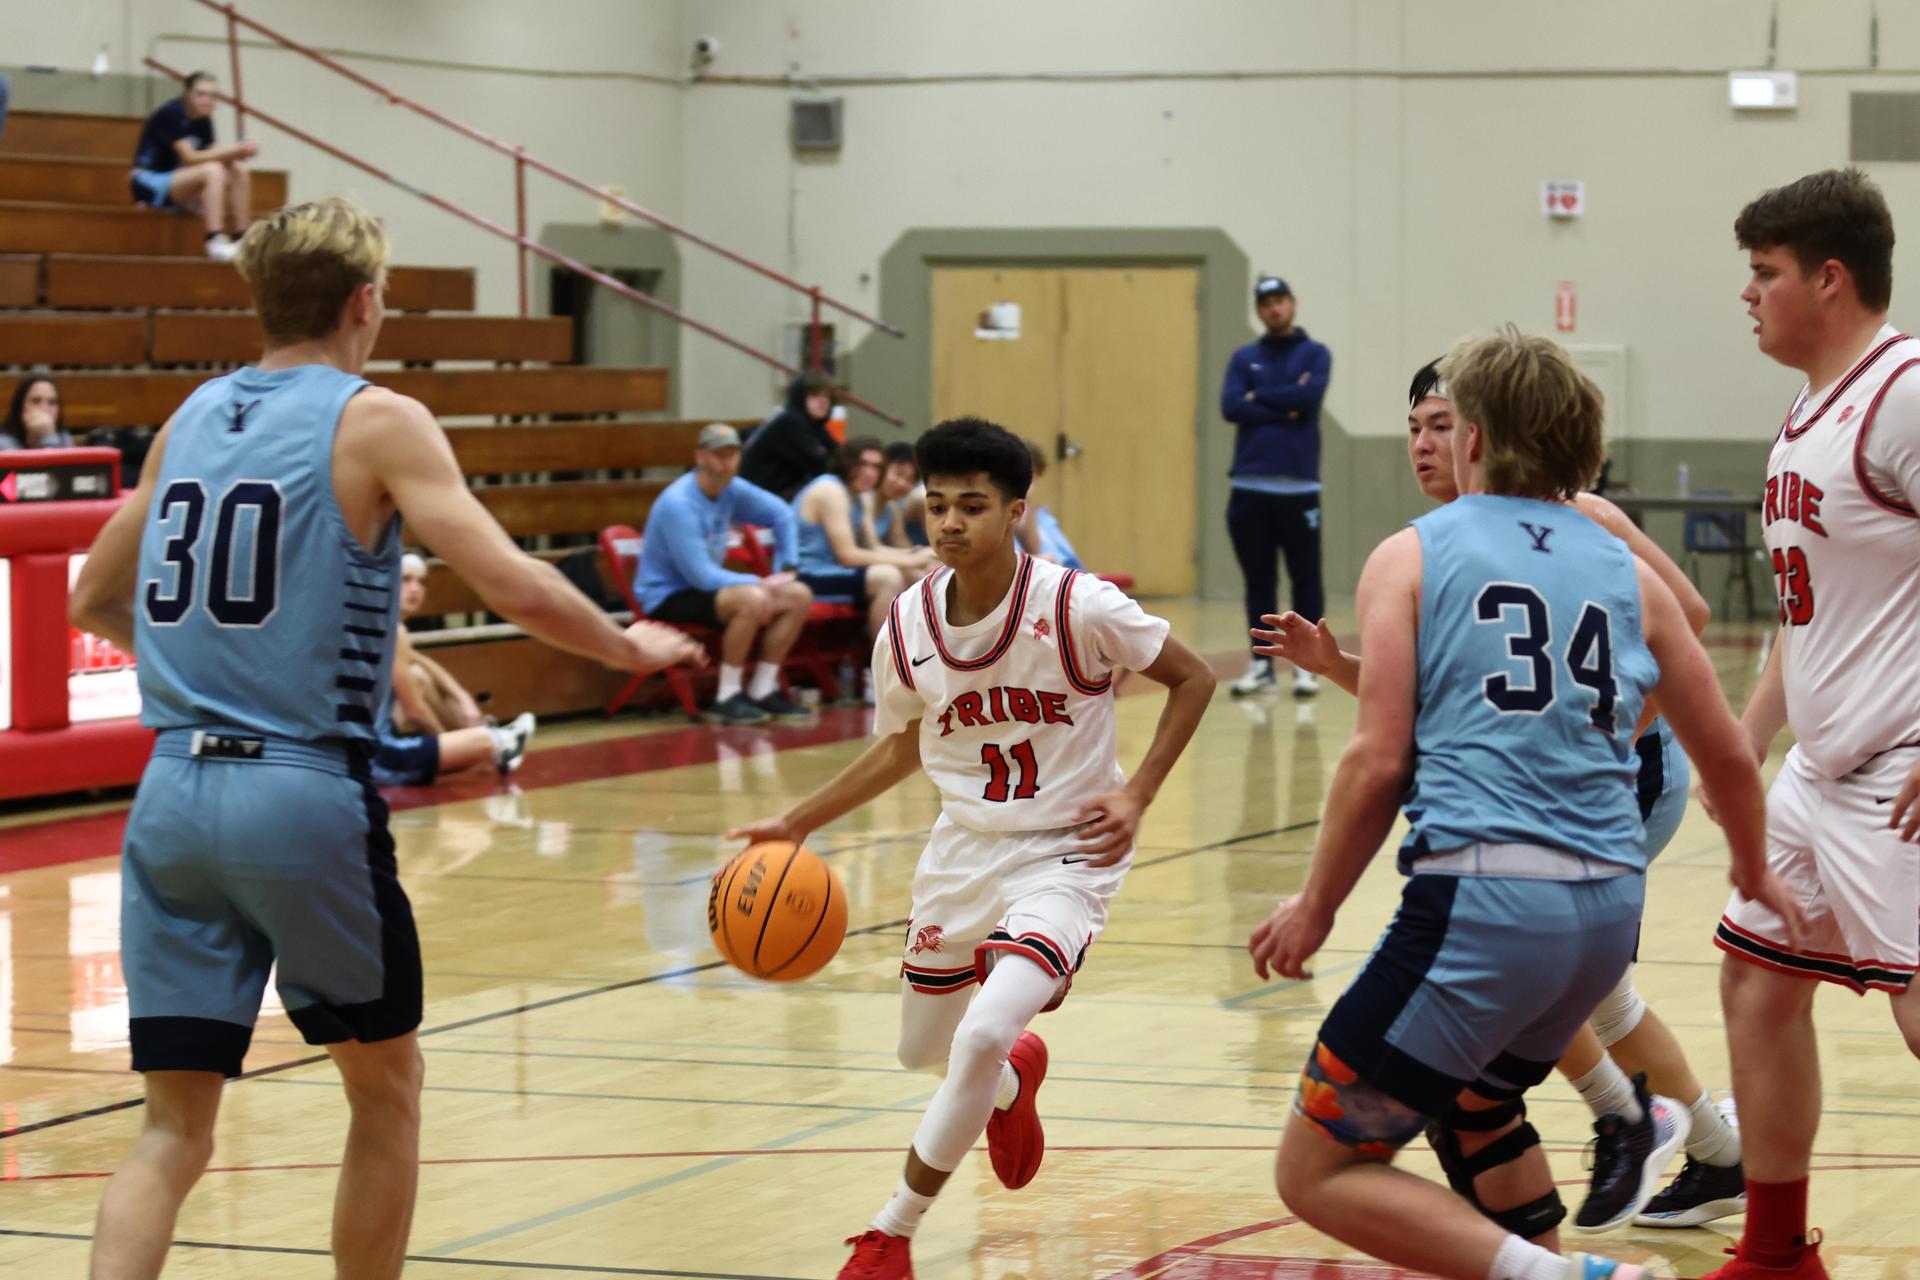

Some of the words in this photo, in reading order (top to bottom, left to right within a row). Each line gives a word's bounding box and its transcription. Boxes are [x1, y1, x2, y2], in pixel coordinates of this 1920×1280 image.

[226, 398, 264, 433] Y
[1518, 520, 1554, 554] Y
[1765, 471, 1829, 539] RIBE
[143, 477, 287, 629] 30
[1472, 580, 1623, 739] 34
[937, 686, 1074, 737] TRIBE
[981, 738, 1040, 802] 11
